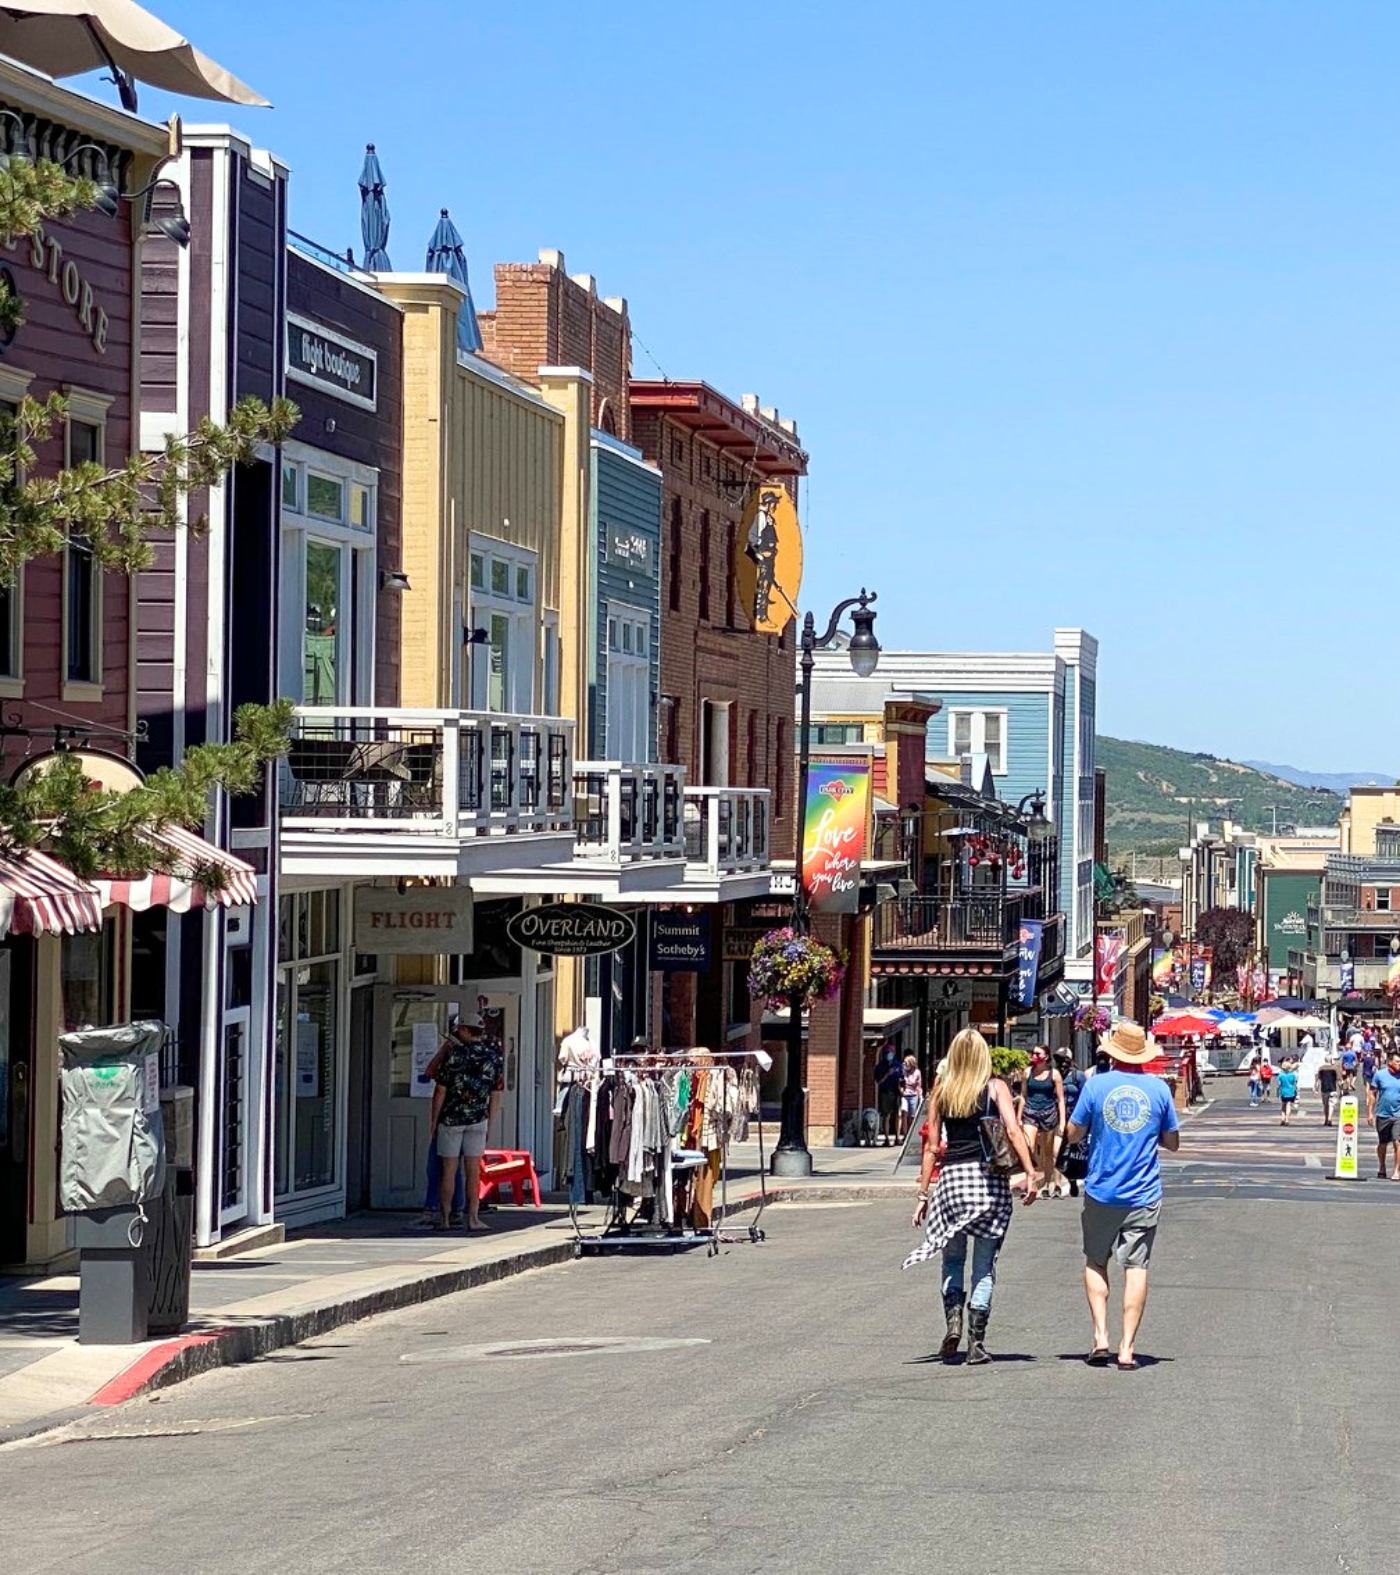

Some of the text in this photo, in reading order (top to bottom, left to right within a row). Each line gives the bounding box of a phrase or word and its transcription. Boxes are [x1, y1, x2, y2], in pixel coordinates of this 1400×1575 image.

[30, 222, 110, 355] STORE
[324, 341, 361, 390] boutique
[802, 808, 858, 865] Love
[824, 852, 857, 872] where
[808, 871, 834, 895] you
[832, 873, 856, 893] live
[370, 911, 457, 929] FLIGHT
[658, 924, 700, 936] Summit
[656, 943, 705, 958] Sotheby's
